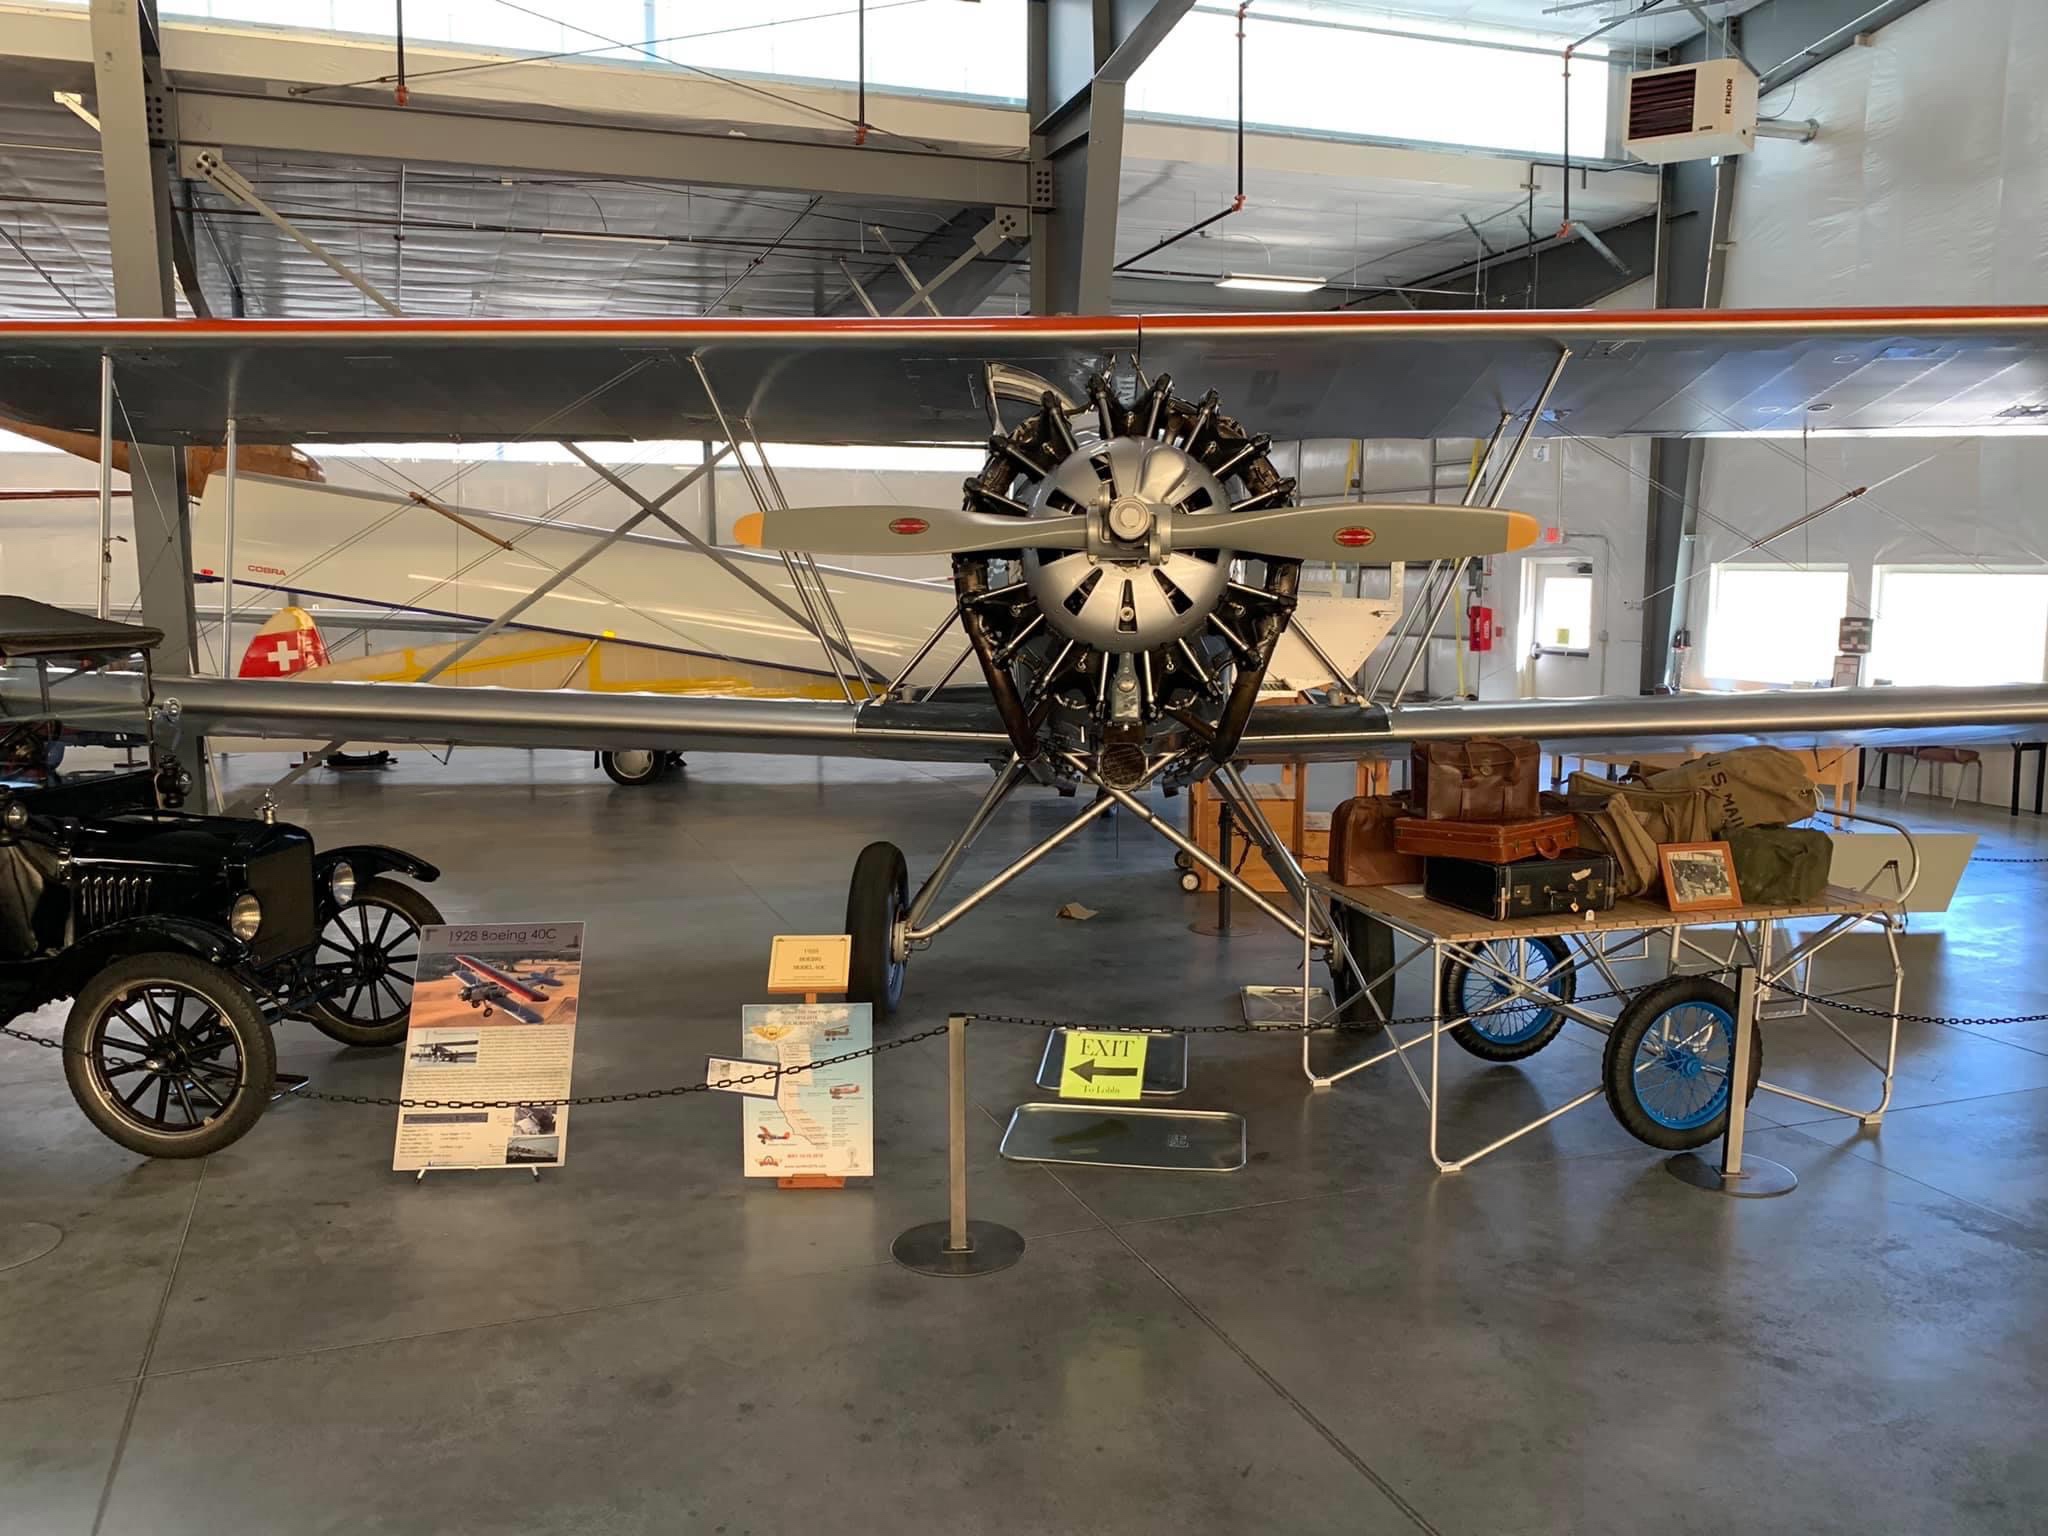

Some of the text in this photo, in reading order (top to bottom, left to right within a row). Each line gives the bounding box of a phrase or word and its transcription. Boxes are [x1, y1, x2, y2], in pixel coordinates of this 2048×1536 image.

[247, 564, 286, 576] COBRA
[449, 928, 557, 943] 1928 Boeing 40C
[1081, 1038, 1136, 1057] EXIT
[1084, 1084, 1120, 1094] To Lobby
